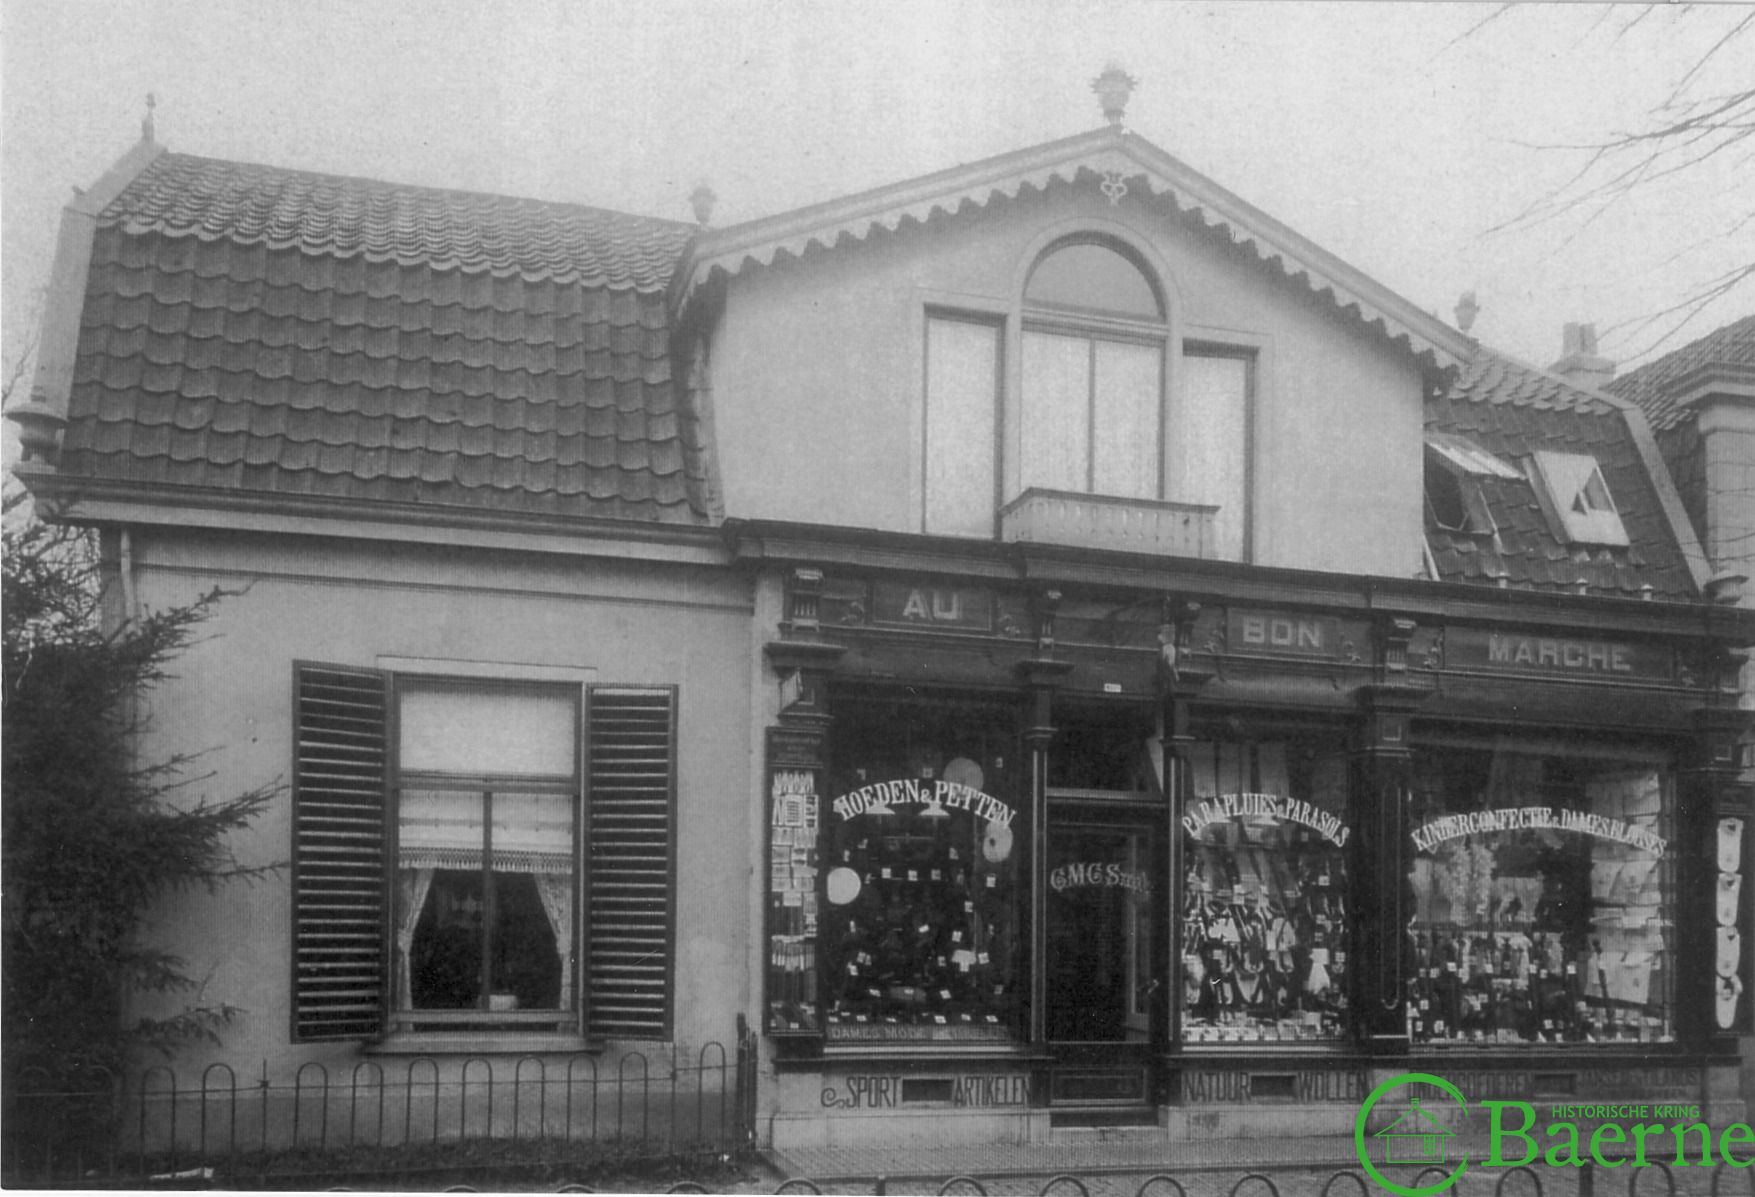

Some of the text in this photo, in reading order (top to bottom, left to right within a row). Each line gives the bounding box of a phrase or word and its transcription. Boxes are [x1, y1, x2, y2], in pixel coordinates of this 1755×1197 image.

[902, 587, 1632, 672] AU BON MARCHE
[833, 779, 919, 821] HOEDEN
[934, 780, 1017, 827] PETTEN
[1182, 793, 1277, 840] PARAPLUIES
[1286, 797, 1350, 848] PARASOLS
[1411, 807, 1552, 852] KINDERCONFECTIE
[845, 1073, 1031, 1108] SPORT ARTIKELEN
[1182, 1071, 1370, 1103] NATUUR WOLLEN
